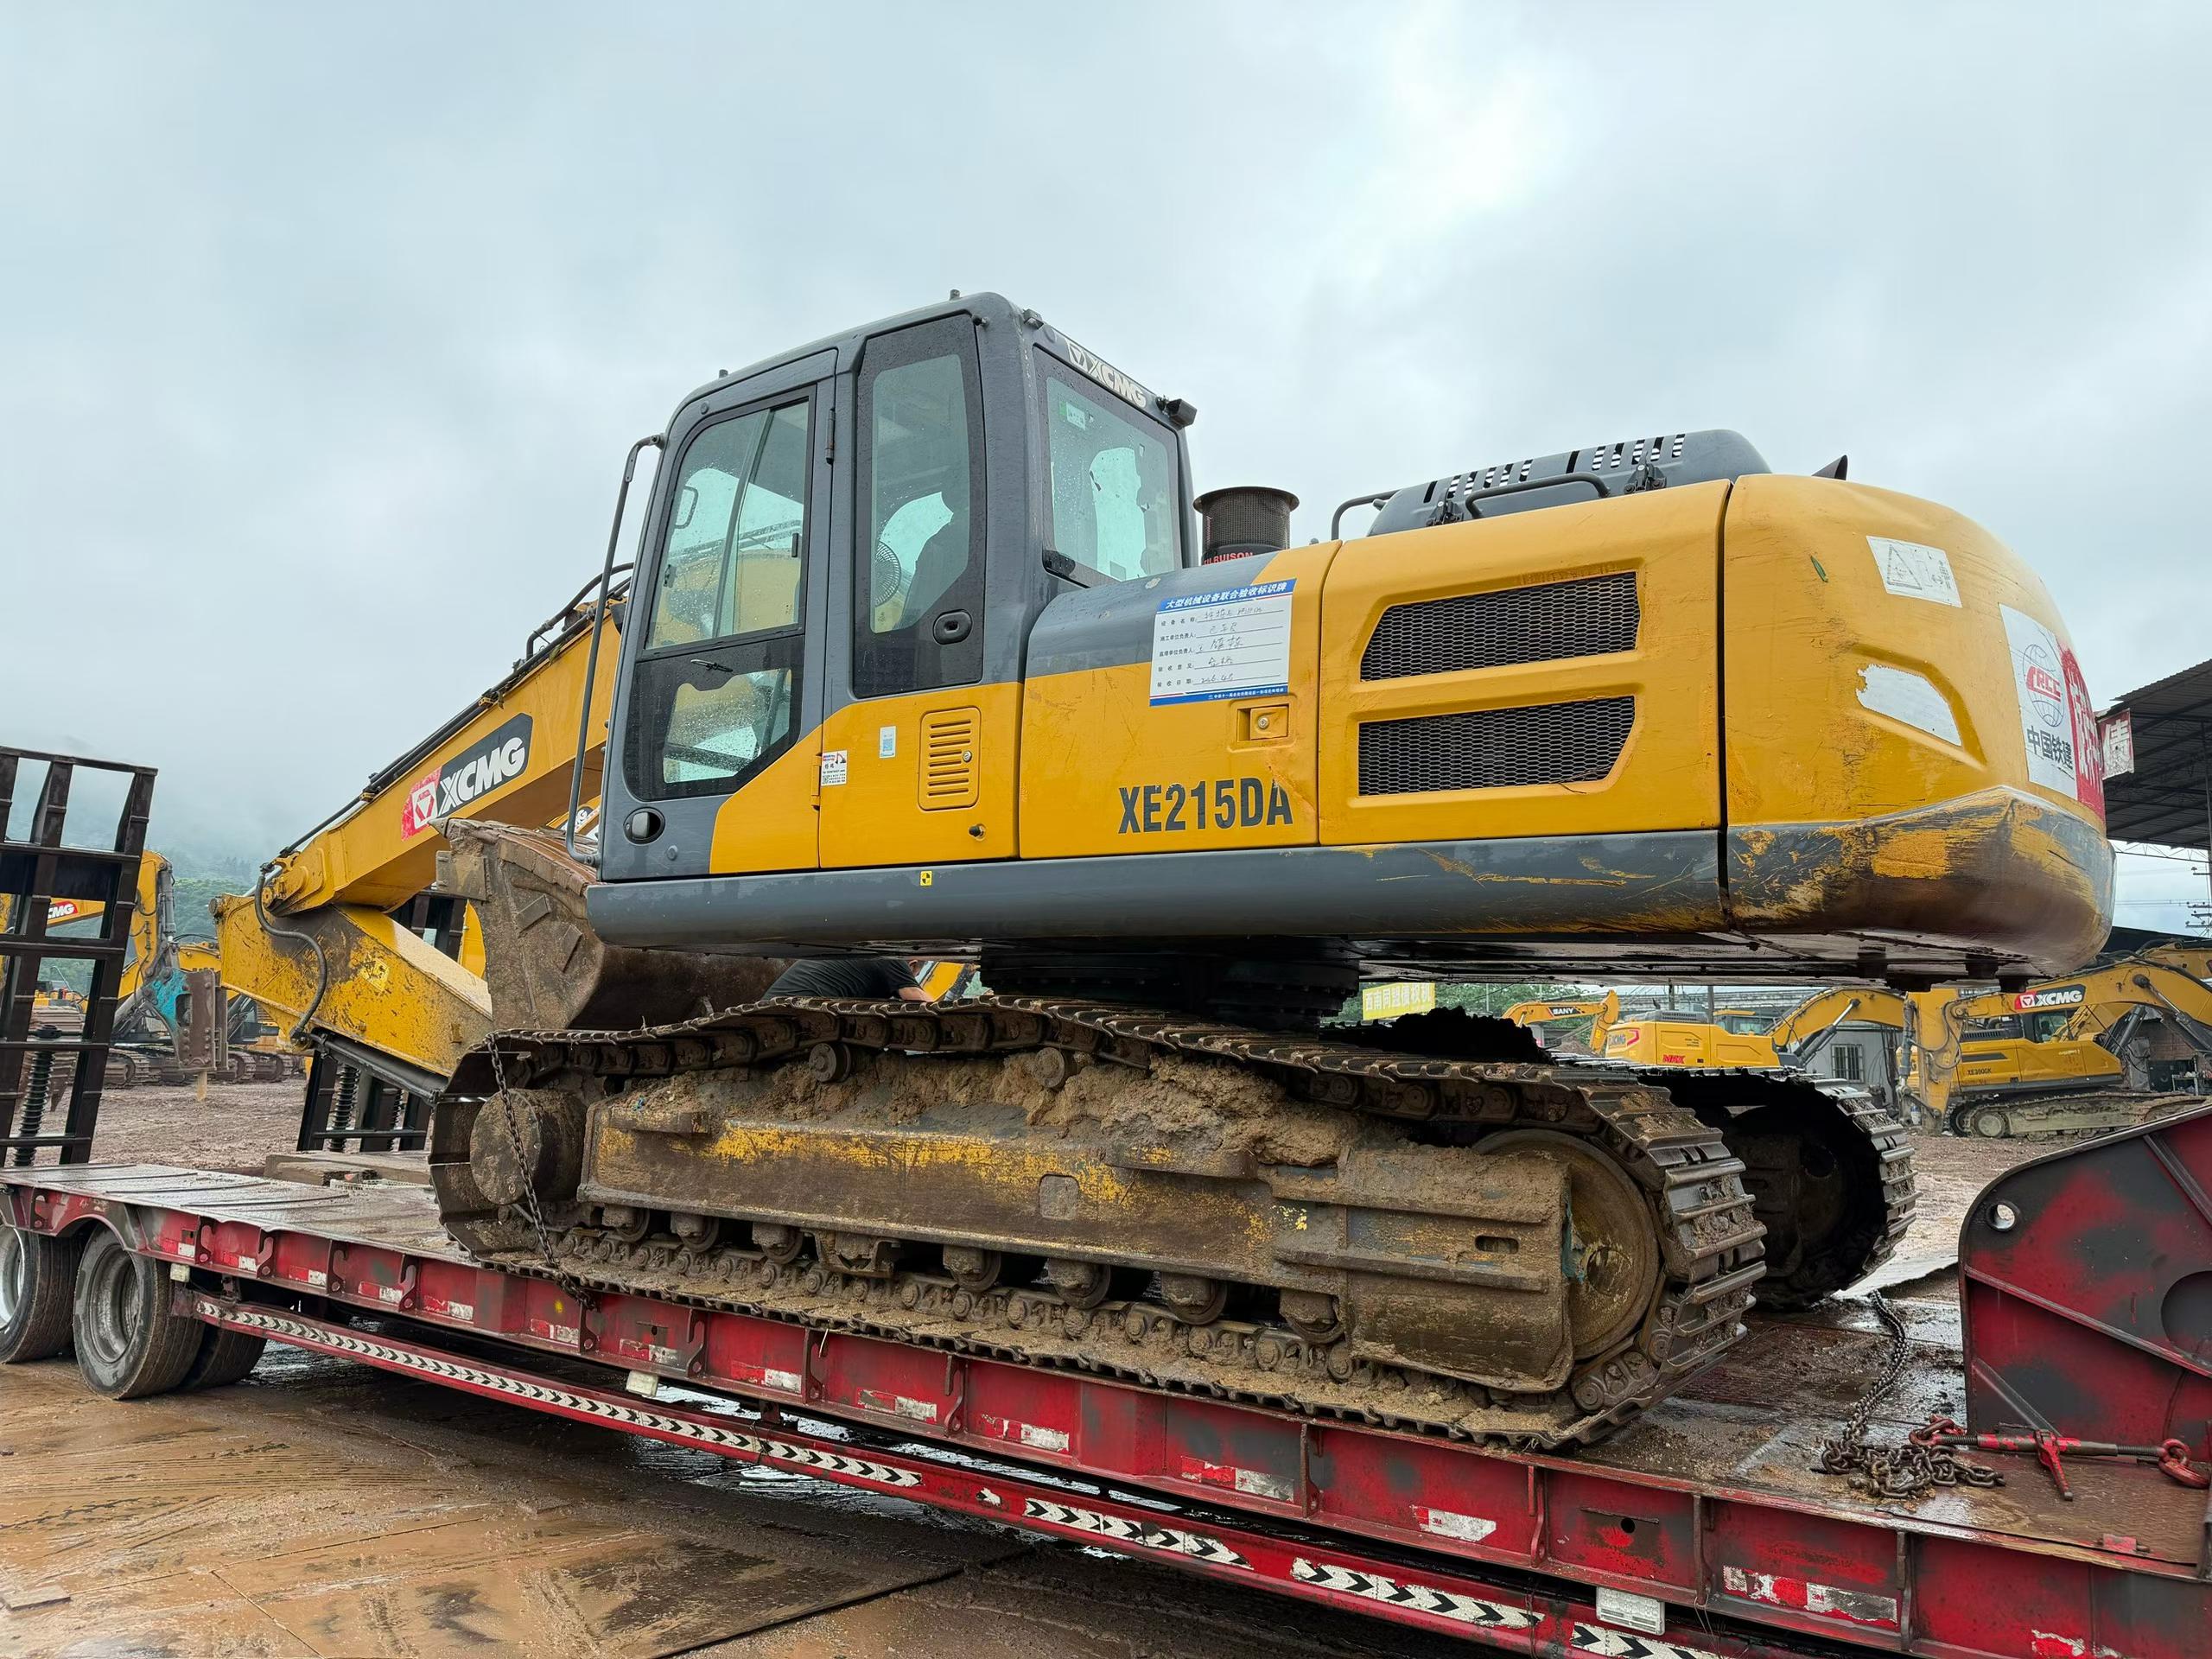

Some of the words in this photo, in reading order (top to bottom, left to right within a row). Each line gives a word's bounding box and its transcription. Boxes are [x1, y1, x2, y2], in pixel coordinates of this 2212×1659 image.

[1086, 352, 1147, 408] XCMG
[2027, 725, 2073, 770] 中国铁建
[438, 737, 526, 816] XCMG
[1117, 778, 1294, 835] XE215DA
[48, 903, 75, 919] CMG
[2035, 990, 2083, 1007] XCMG
